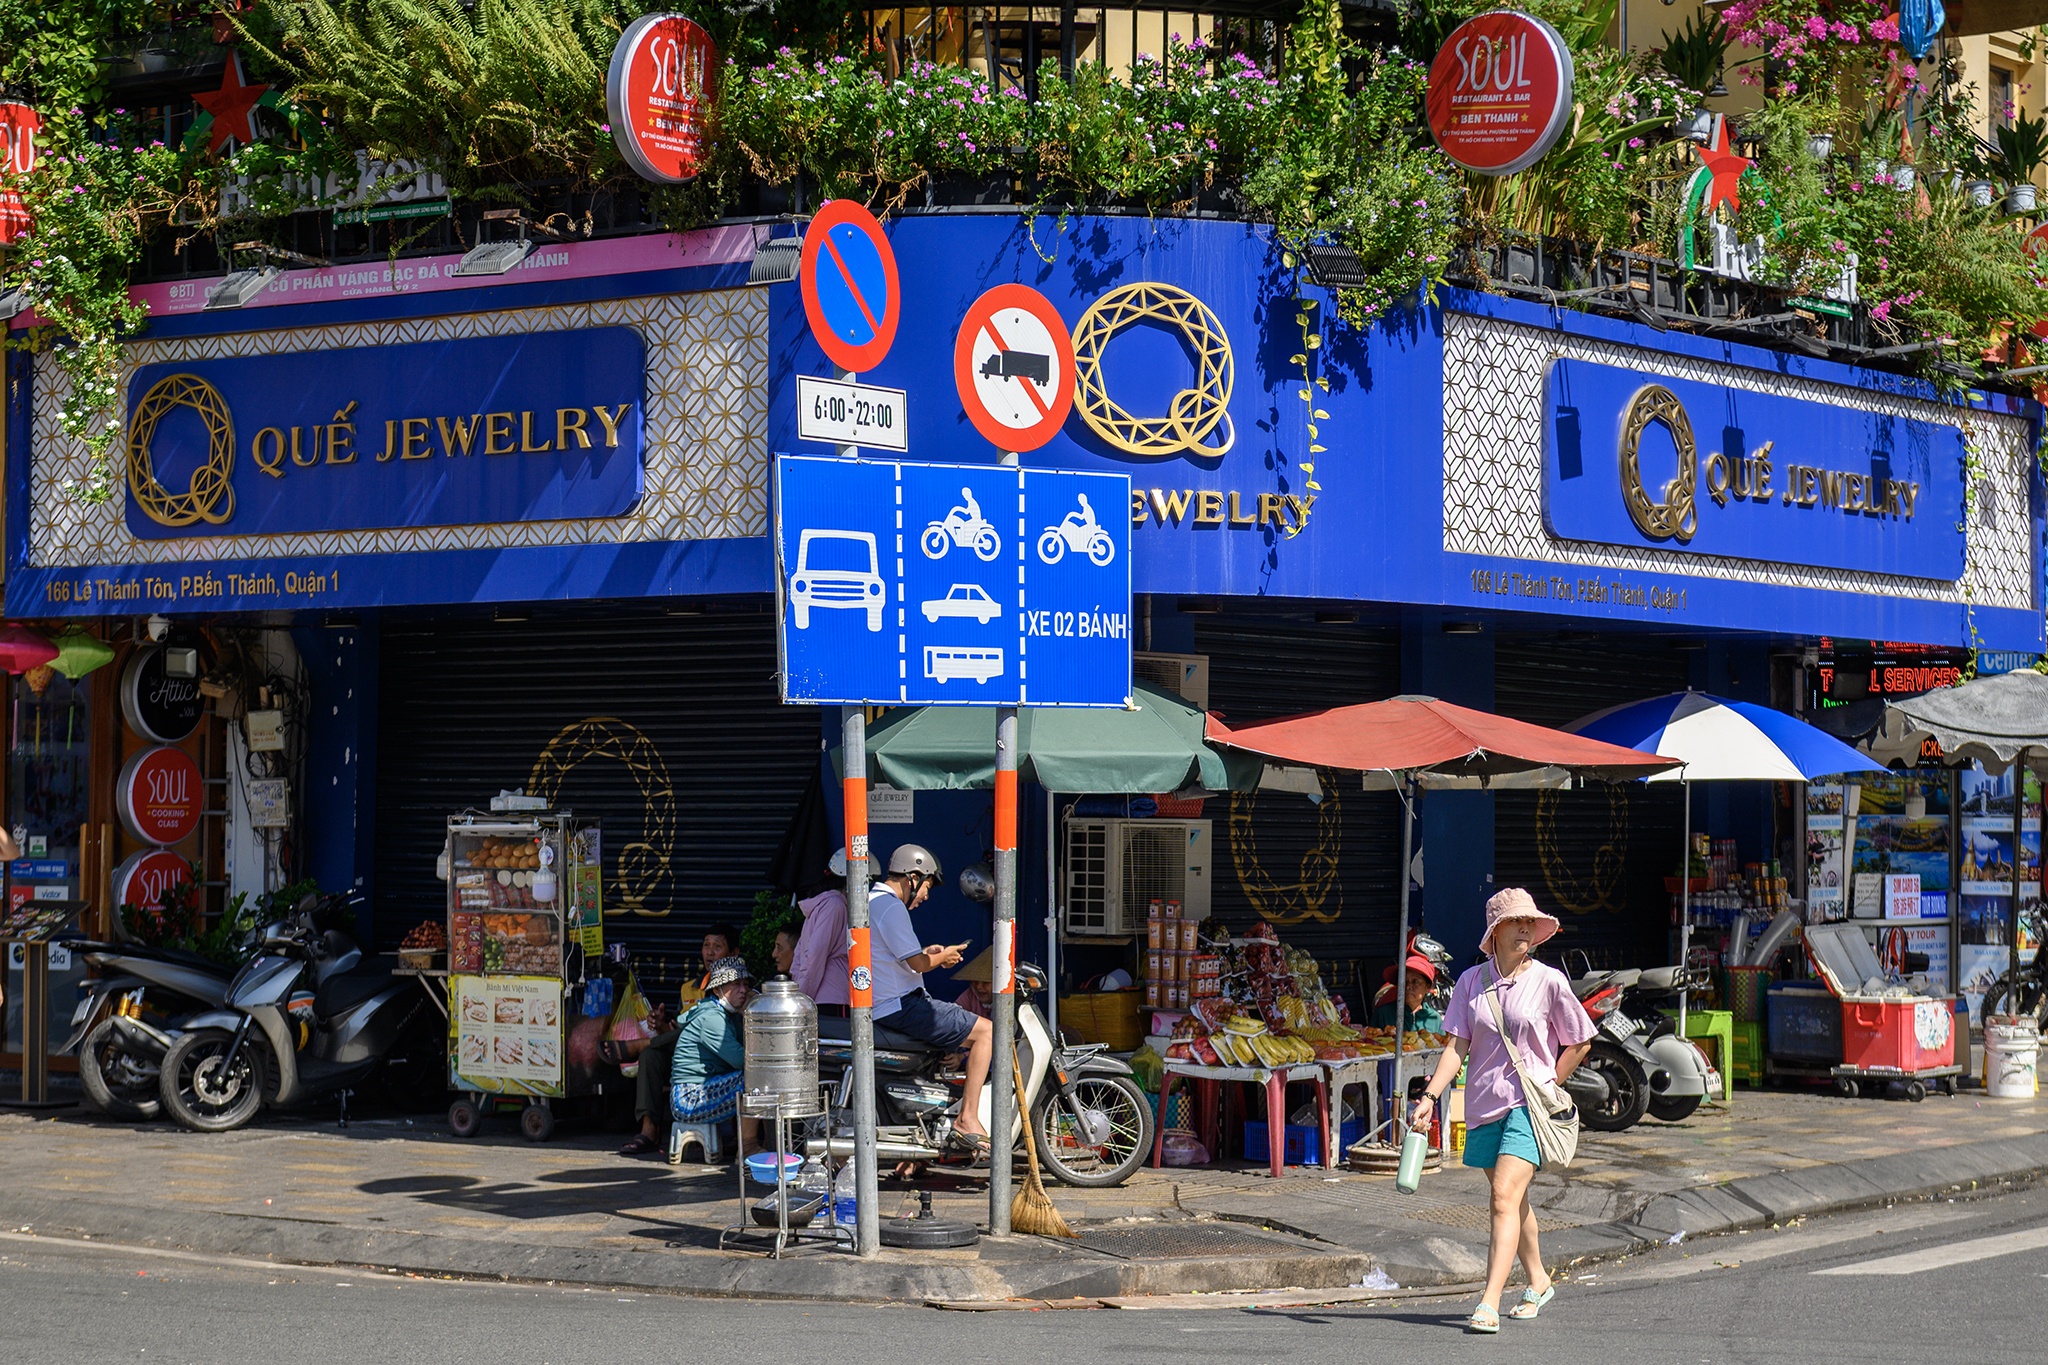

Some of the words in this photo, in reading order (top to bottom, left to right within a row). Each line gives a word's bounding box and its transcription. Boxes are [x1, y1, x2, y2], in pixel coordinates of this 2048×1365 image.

[650, 36, 710, 101] SOUL
[1455, 32, 1531, 92] SOUL
[1452, 94, 1503, 104] RESTAURANT
[1505, 94, 1512, 102] &
[1514, 93, 1531, 102] BAR
[656, 118, 673, 130] BEN
[1461, 114, 1482, 124] BEN
[1484, 113, 1519, 124] THANH
[178, 283, 195, 298] BTJ
[292, 272, 334, 291] PHẦN
[417, 263, 440, 280] ĐÁ
[365, 285, 392, 294] HÀNG
[252, 400, 359, 478] QUẾ
[376, 402, 633, 462] JEWELRY
[1705, 441, 1774, 505] QUẾ
[1783, 464, 1920, 517] JEWELRY
[1132, 488, 1318, 526] EWELRY
[45, 580, 70, 602] 166
[74, 578, 92, 601] Lê
[95, 577, 140, 601] Thánh
[144, 576, 177, 602] Tôn,
[180, 570, 223, 599] P.Bến
[284, 570, 327, 598] Quận
[331, 569, 339, 592] 1
[1471, 568, 1491, 593] 166
[1495, 572, 1509, 595] Lê
[1511, 573, 1548, 599] Thánh
[1550, 576, 1575, 604] Tôn,
[1577, 575, 1609, 604] P.Bến
[1651, 585, 1679, 614] Quận
[1680, 588, 1688, 611] 1
[1027, 610, 1051, 637] XE
[1054, 611, 1074, 637] 02
[1078, 604, 1126, 639] BÁNH
[149, 679, 196, 709] Attic
[1884, 666, 1961, 694] SERVICES
[147, 768, 190, 804] SOUL
[151, 807, 185, 818] COOKING
[157, 818, 179, 829] CLASS
[1916, 930, 1936, 940] TOUR
[486, 983, 502, 992] Bánh
[512, 985, 524, 994] Việt
[524, 986, 540, 994] Nam
[893, 1086, 916, 1094] HONDA
